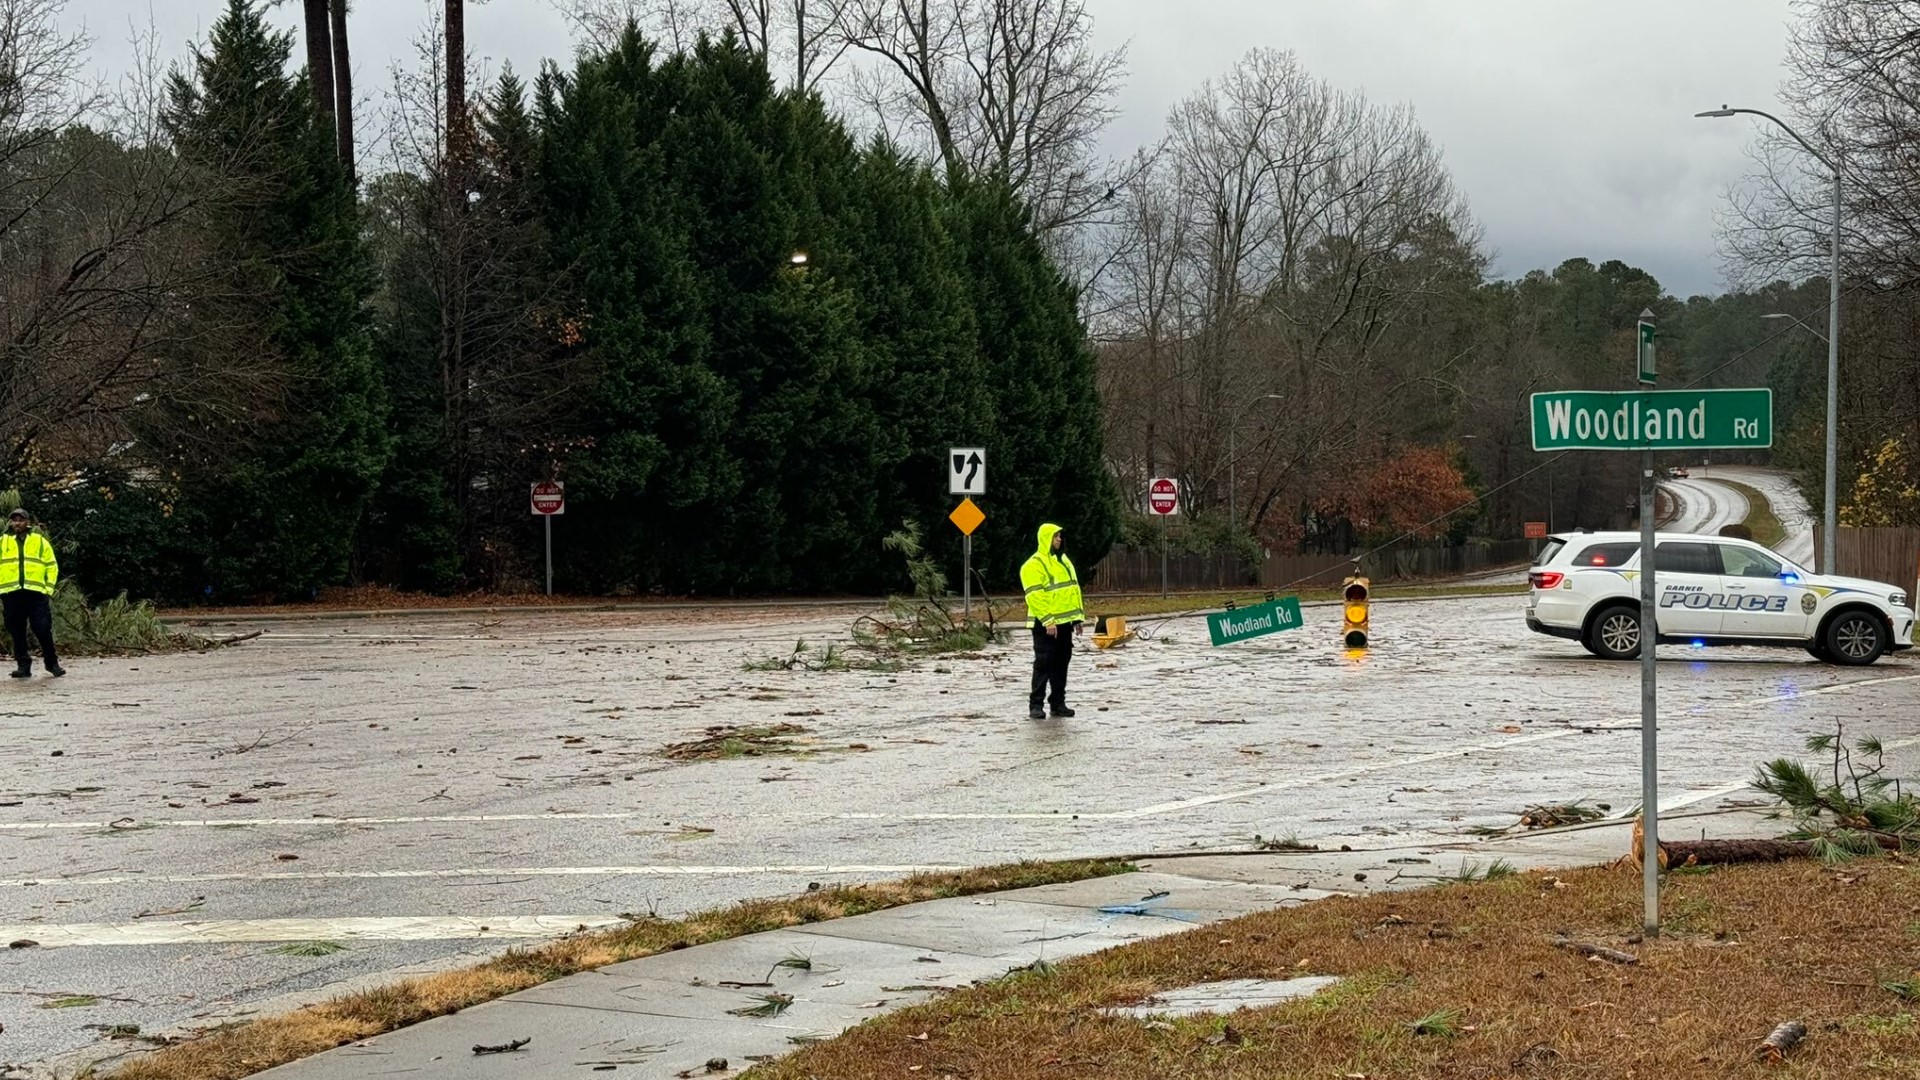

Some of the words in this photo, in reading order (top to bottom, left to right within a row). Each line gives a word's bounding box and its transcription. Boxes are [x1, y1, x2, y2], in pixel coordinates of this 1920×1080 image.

[1545, 399, 1705, 440] Woodland
[1734, 417, 1759, 439] Rd
[1660, 592, 1788, 612] POLICE
[1219, 614, 1272, 638] Woodland
[1275, 606, 1292, 625] Rd
